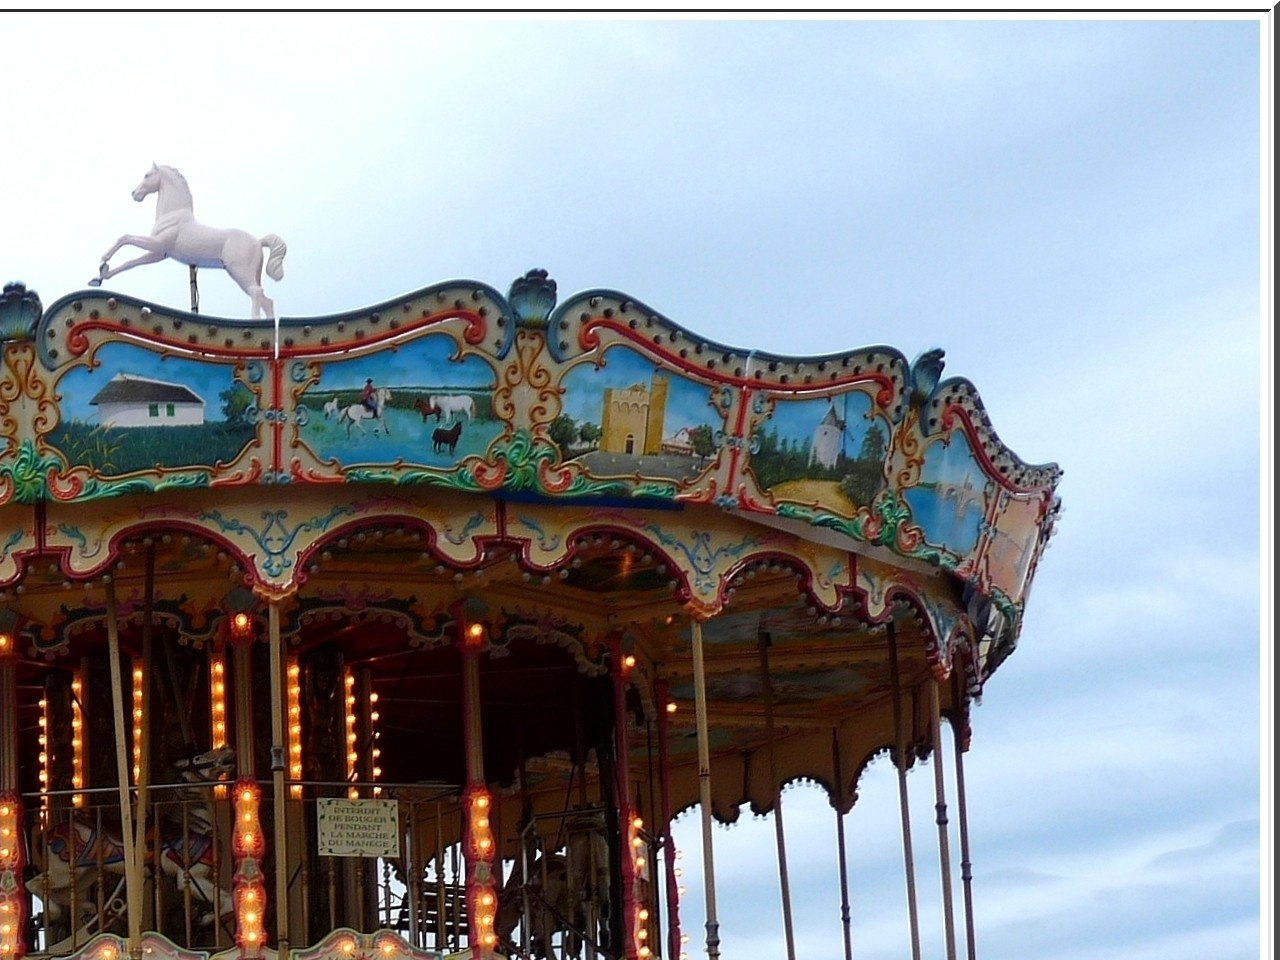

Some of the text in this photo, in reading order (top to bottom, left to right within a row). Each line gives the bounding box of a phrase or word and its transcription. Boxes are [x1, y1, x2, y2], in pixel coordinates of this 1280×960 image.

[334, 807, 381, 815] INTERDIT
[344, 815, 387, 823] BOUGER
[334, 823, 382, 831] PENDANT
[345, 832, 389, 840] MARCHE
[328, 839, 343, 847] DU
